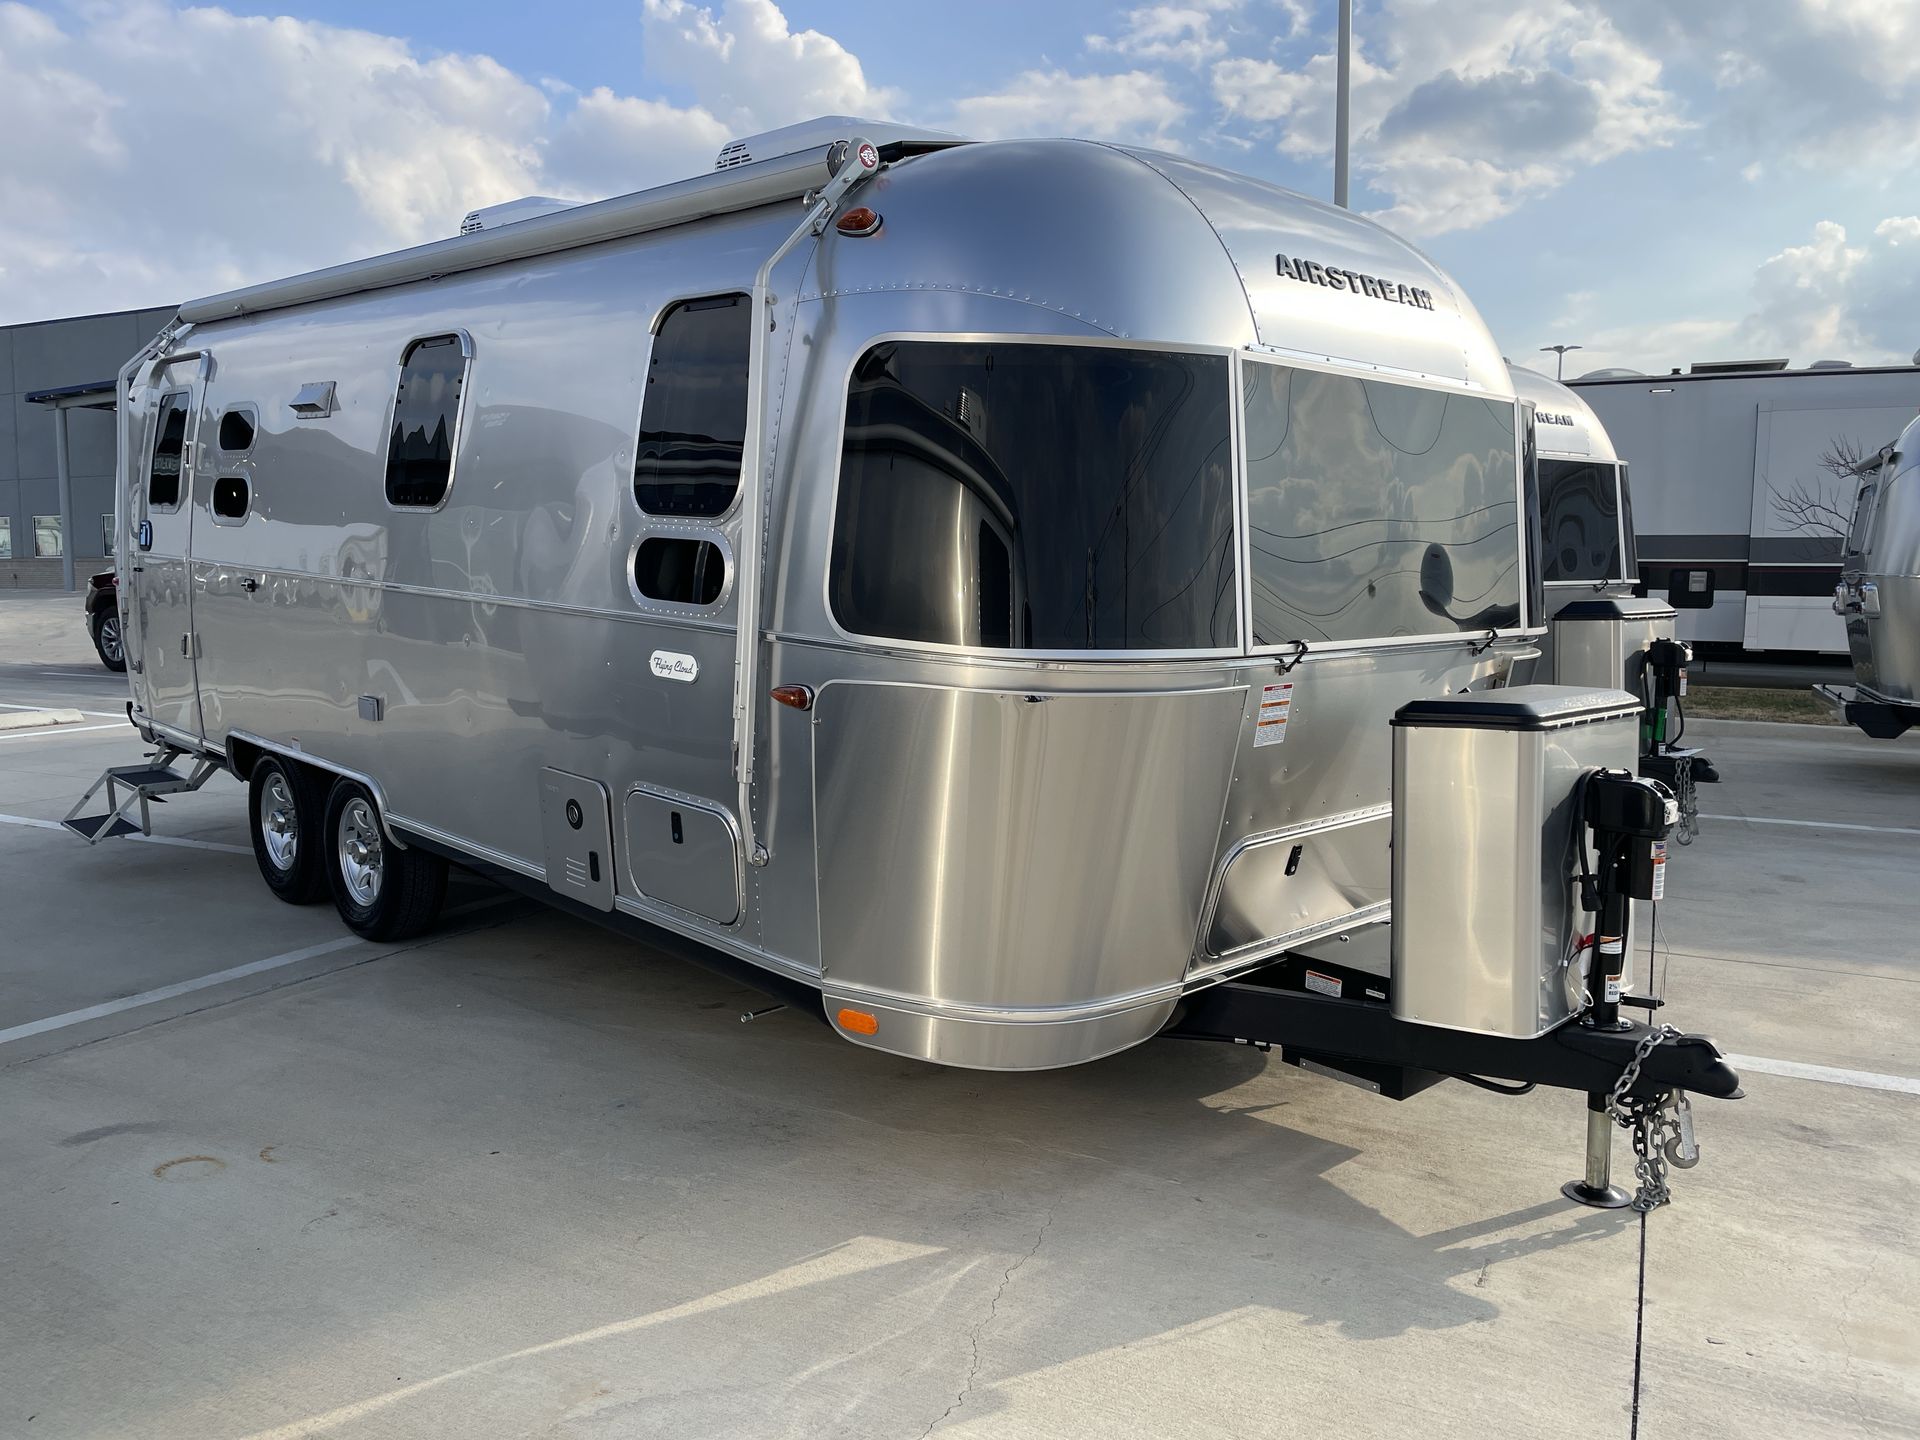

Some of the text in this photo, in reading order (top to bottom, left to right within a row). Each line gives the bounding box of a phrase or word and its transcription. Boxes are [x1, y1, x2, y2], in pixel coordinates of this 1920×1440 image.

[1275, 253, 1435, 312] AIRSTREAM
[1535, 411, 1575, 427] REAM
[653, 656, 694, 675] Flying Cloud
